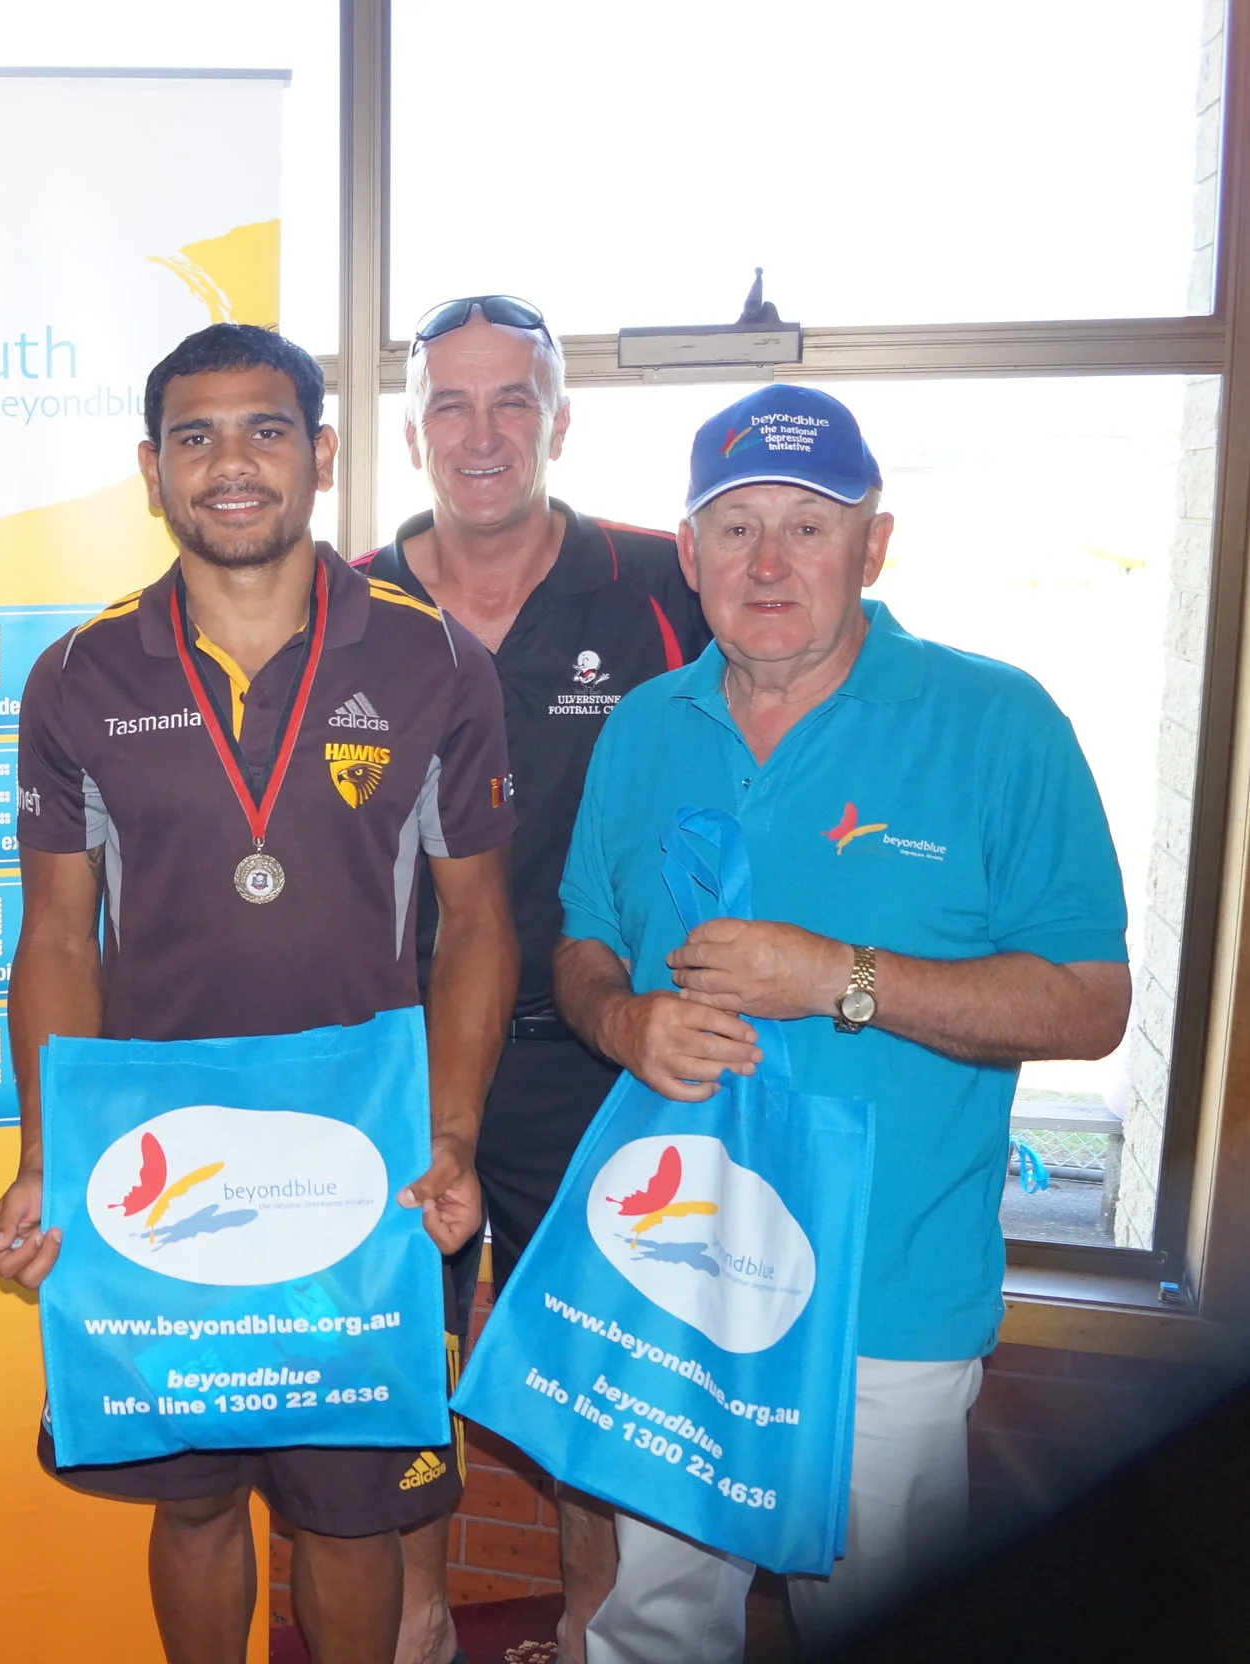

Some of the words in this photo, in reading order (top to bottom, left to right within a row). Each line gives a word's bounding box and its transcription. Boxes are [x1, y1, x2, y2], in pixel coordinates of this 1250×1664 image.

[751, 413, 830, 427] beyondblue
[760, 425, 777, 434] the
[780, 425, 818, 436] national
[765, 434, 814, 445] depression
[768, 442, 811, 452] initiative
[549, 706, 600, 714] FOOTBALL
[104, 708, 202, 737] Tasmania
[328, 713, 390, 732] adidas
[325, 742, 391, 765] HAWKS
[883, 834, 947, 854] beyondblue
[223, 1179, 338, 1202] beyondblue
[84, 1311, 400, 1340] www.beyondblue.org.au
[544, 1292, 800, 1427] www.beyondblue.org.au
[167, 1366, 321, 1392] beyondblue
[103, 1395, 150, 1415] info
[158, 1396, 206, 1415] line
[214, 1393, 277, 1413] 1300
[286, 1391, 317, 1408] 22
[325, 1385, 389, 1405] 4636
[592, 1374, 723, 1459] beyondblue
[525, 1368, 569, 1405] info
[573, 1394, 614, 1431] line
[622, 1422, 683, 1465] 1300
[686, 1454, 716, 1485] 22
[717, 1476, 777, 1510] 4636
[399, 1462, 447, 1490] adidas
